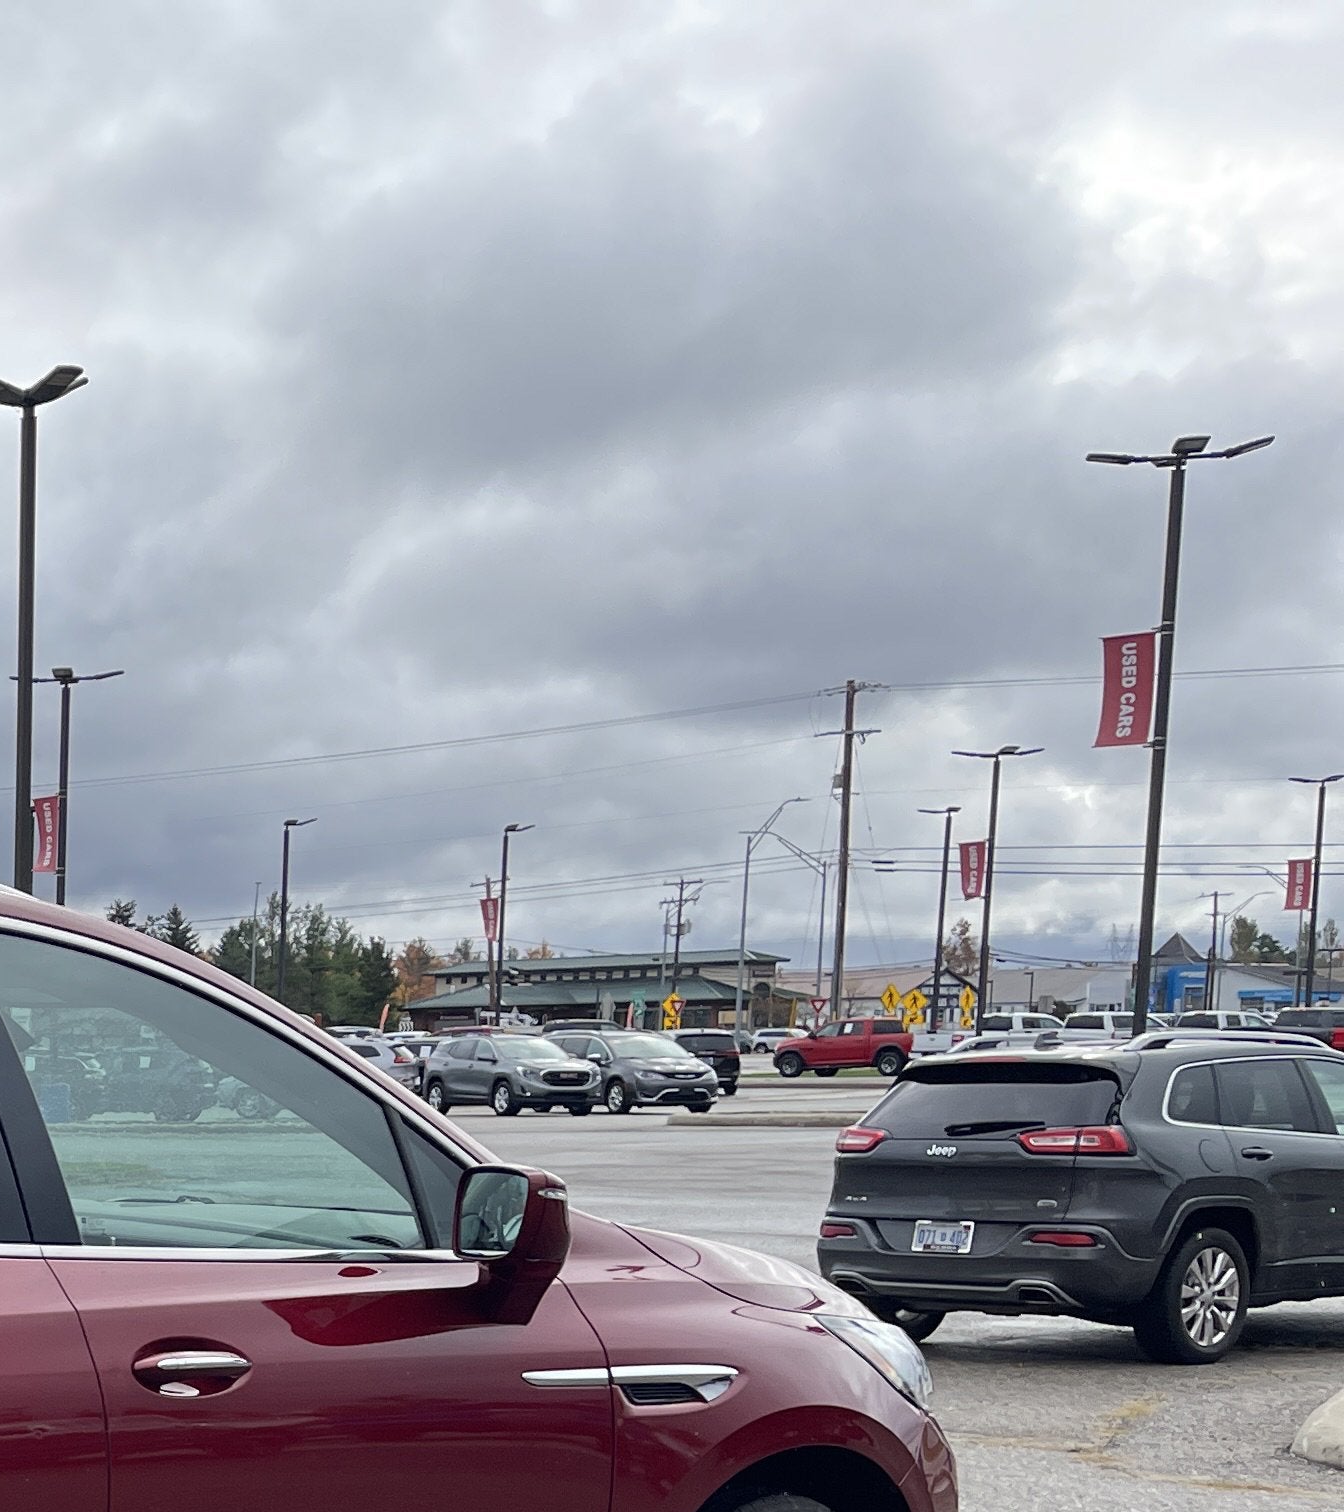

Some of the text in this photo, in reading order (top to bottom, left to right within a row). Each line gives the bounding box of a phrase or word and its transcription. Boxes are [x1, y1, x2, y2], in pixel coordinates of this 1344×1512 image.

[1115, 642, 1137, 738] USED CARS
[43, 802, 53, 833] USED
[926, 1144, 957, 1157] Jeep
[918, 1229, 937, 1245] 071
